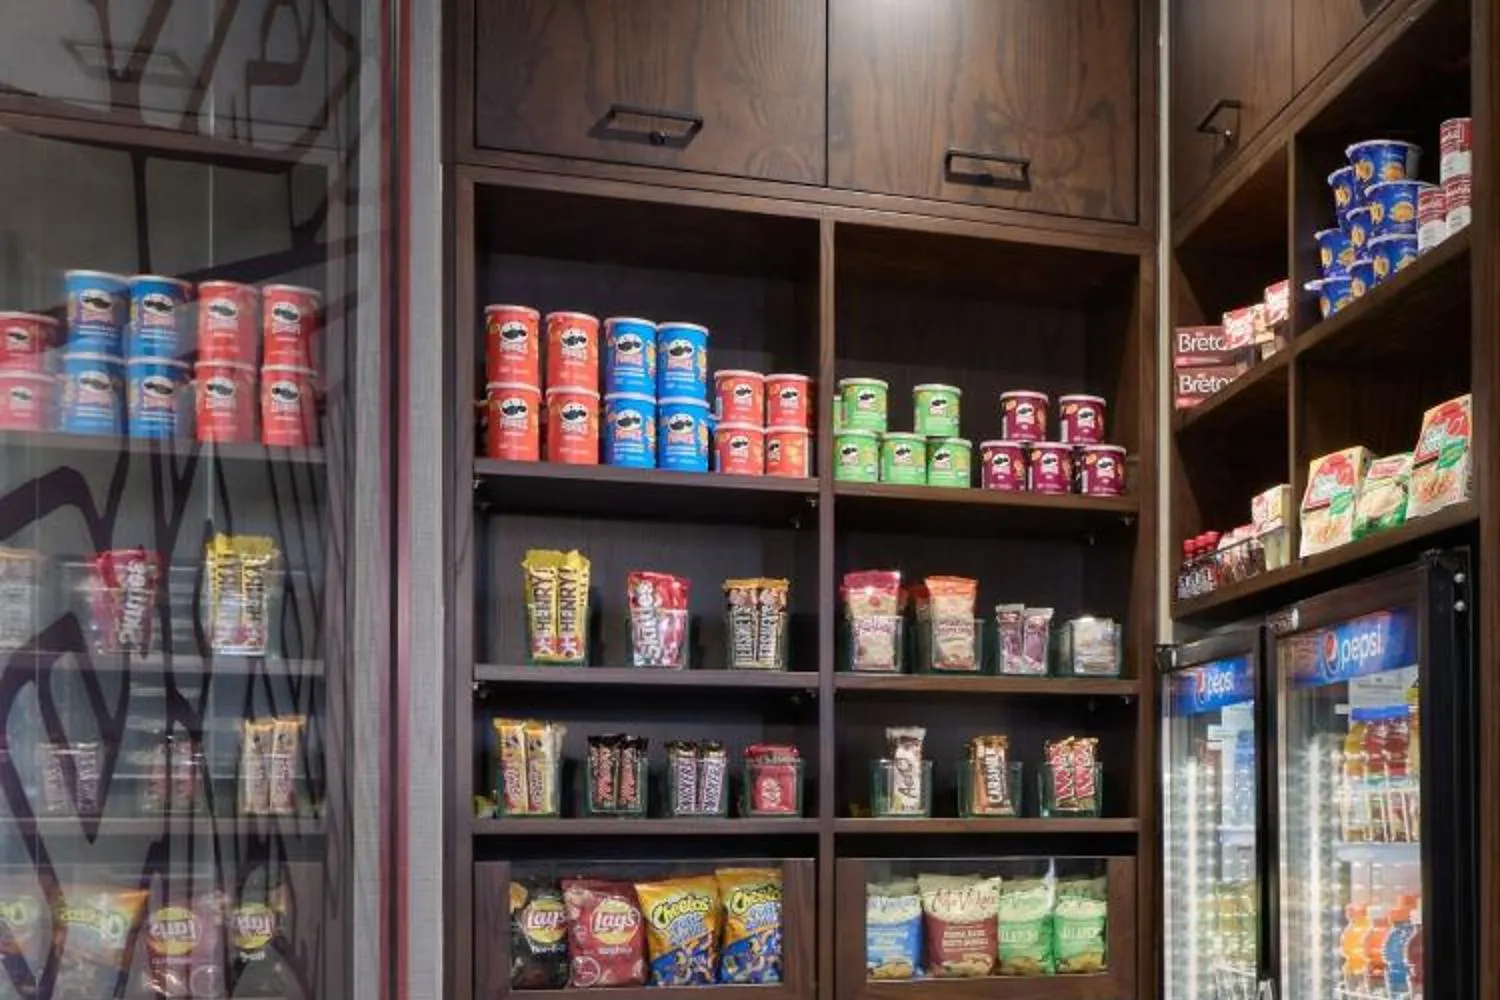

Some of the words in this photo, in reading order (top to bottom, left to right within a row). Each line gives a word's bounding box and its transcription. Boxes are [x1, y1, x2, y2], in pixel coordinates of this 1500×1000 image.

[1179, 332, 1225, 352] Breto
[559, 567, 577, 632] HENRY!
[1341, 624, 1383, 670] pepsi
[1207, 670, 1234, 701] pepsi
